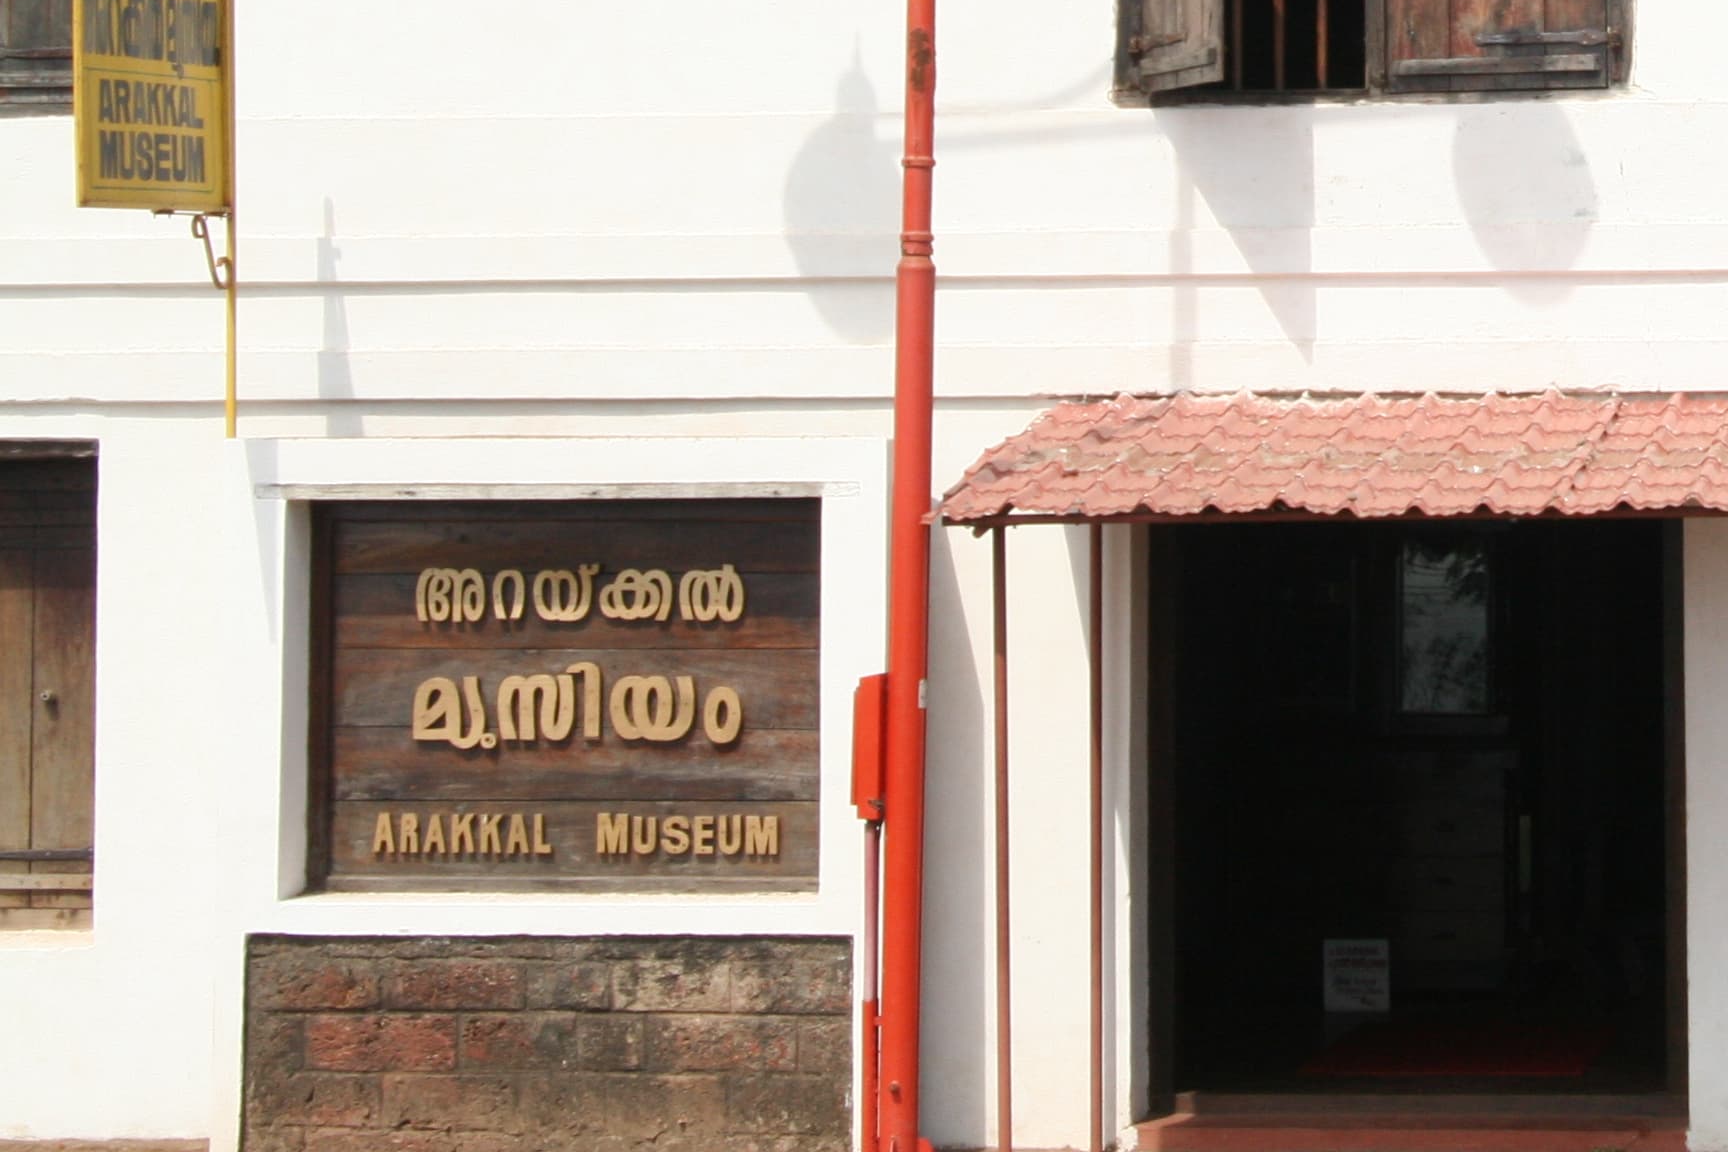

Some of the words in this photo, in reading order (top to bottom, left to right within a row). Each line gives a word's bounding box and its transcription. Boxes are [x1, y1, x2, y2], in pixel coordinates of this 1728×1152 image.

[98, 79, 204, 128] ARAKKAL
[99, 130, 205, 183] MUSEUM
[415, 563, 745, 623] അറയ്ക്കൽ
[412, 662, 743, 750] മ്യൂസിയം
[373, 813, 552, 855] ARAKKAL
[596, 813, 780, 855] MUSEUM
